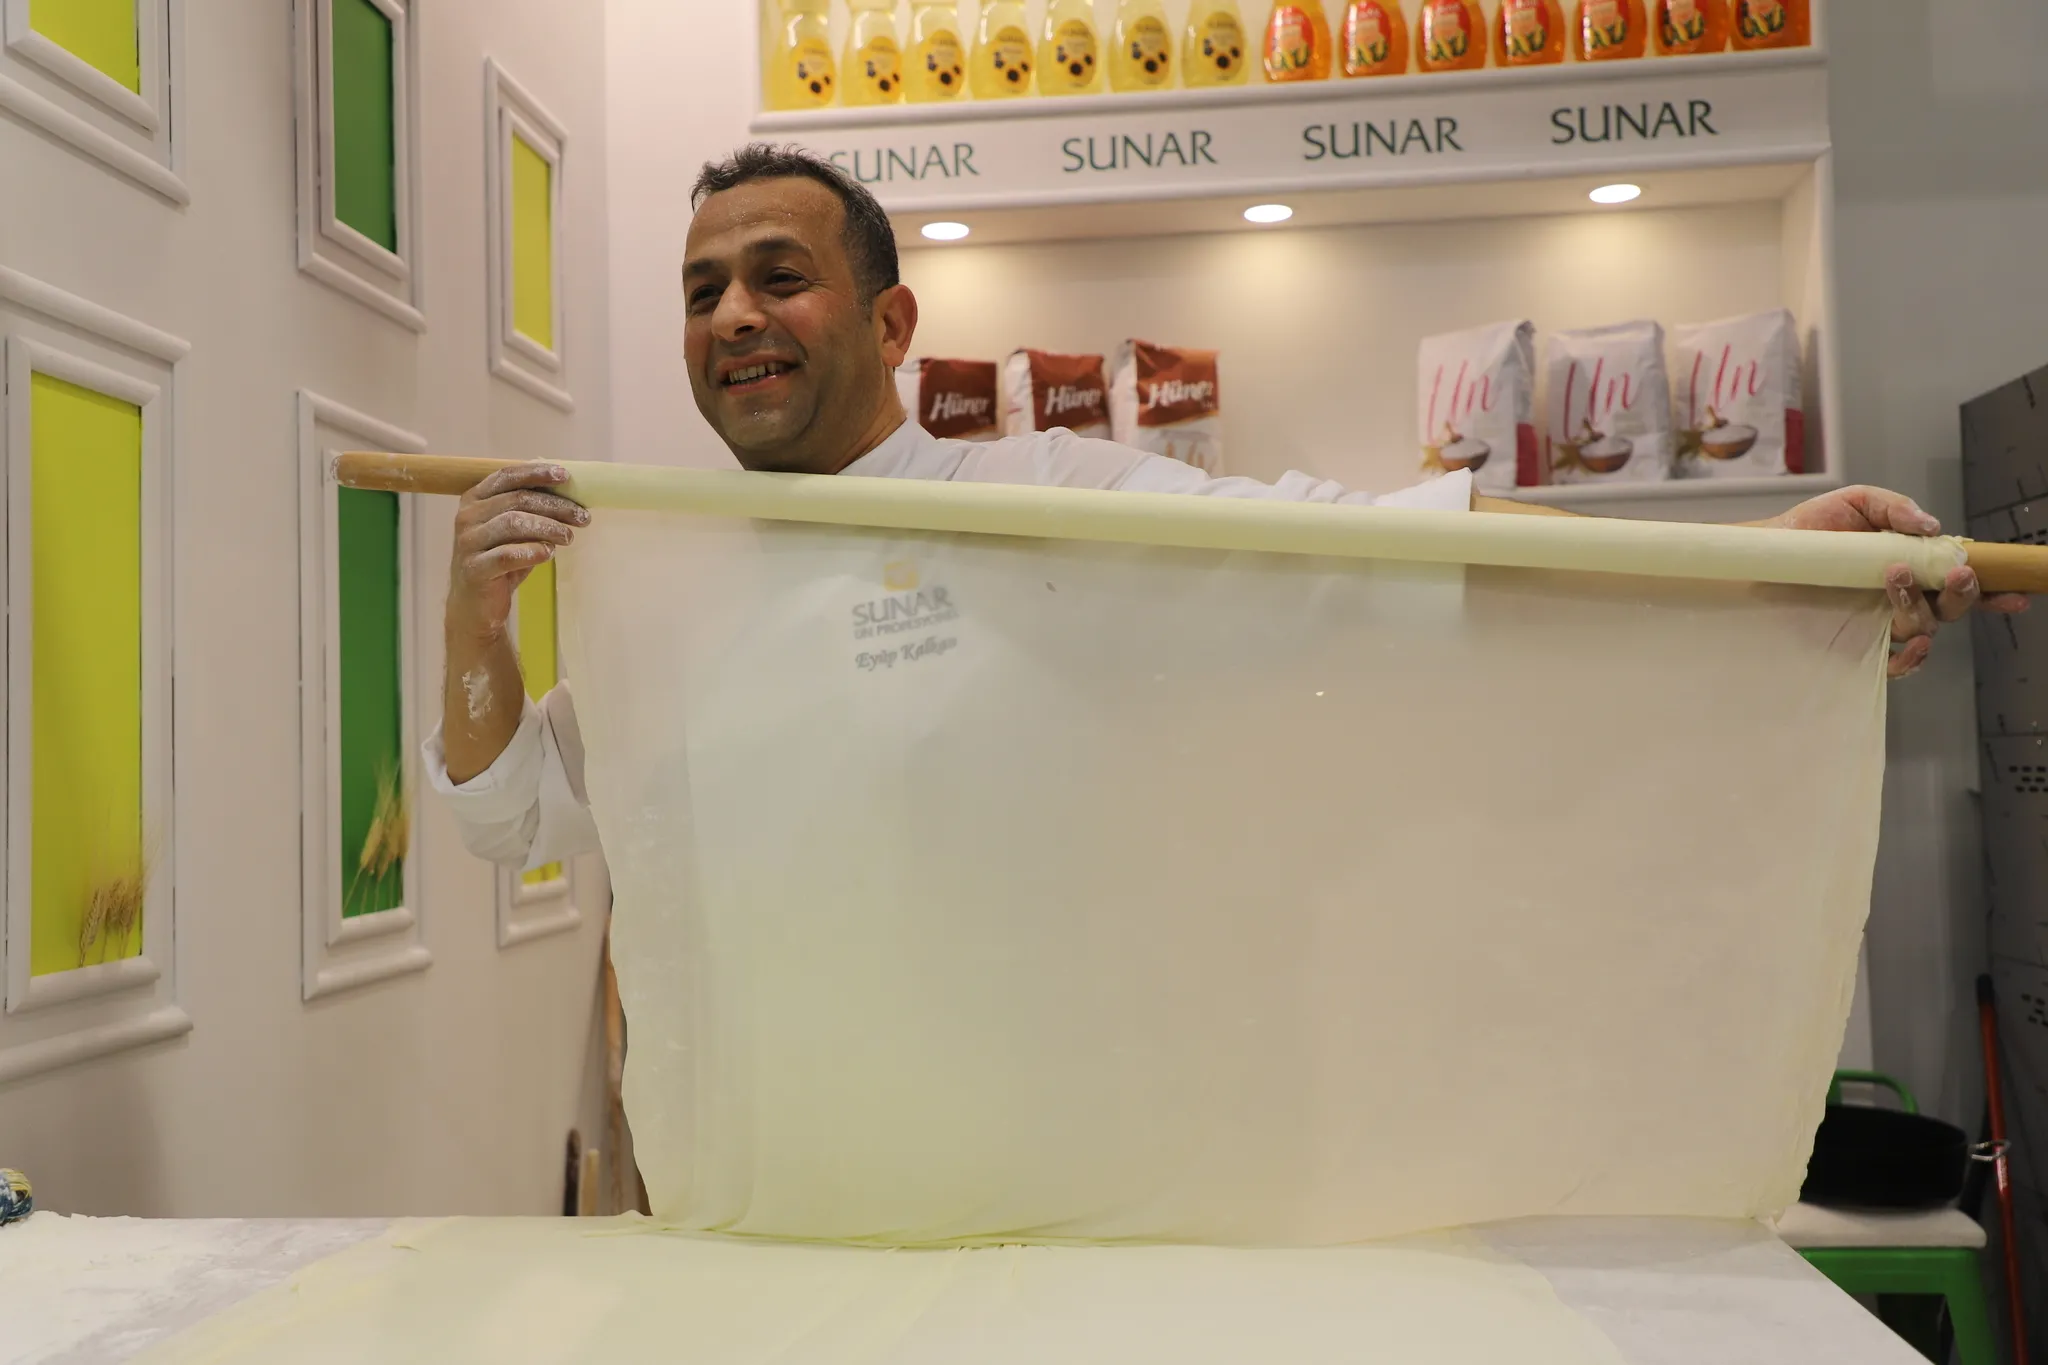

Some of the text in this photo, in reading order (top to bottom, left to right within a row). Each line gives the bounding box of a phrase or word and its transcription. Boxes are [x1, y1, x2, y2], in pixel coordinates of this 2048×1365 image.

[1302, 117, 1463, 160] SUNAR
[1550, 100, 1718, 145] SUNAR
[831, 143, 980, 184] SUNAR
[1062, 130, 1218, 173] SUNAR
[852, 586, 954, 627] SUNAR
